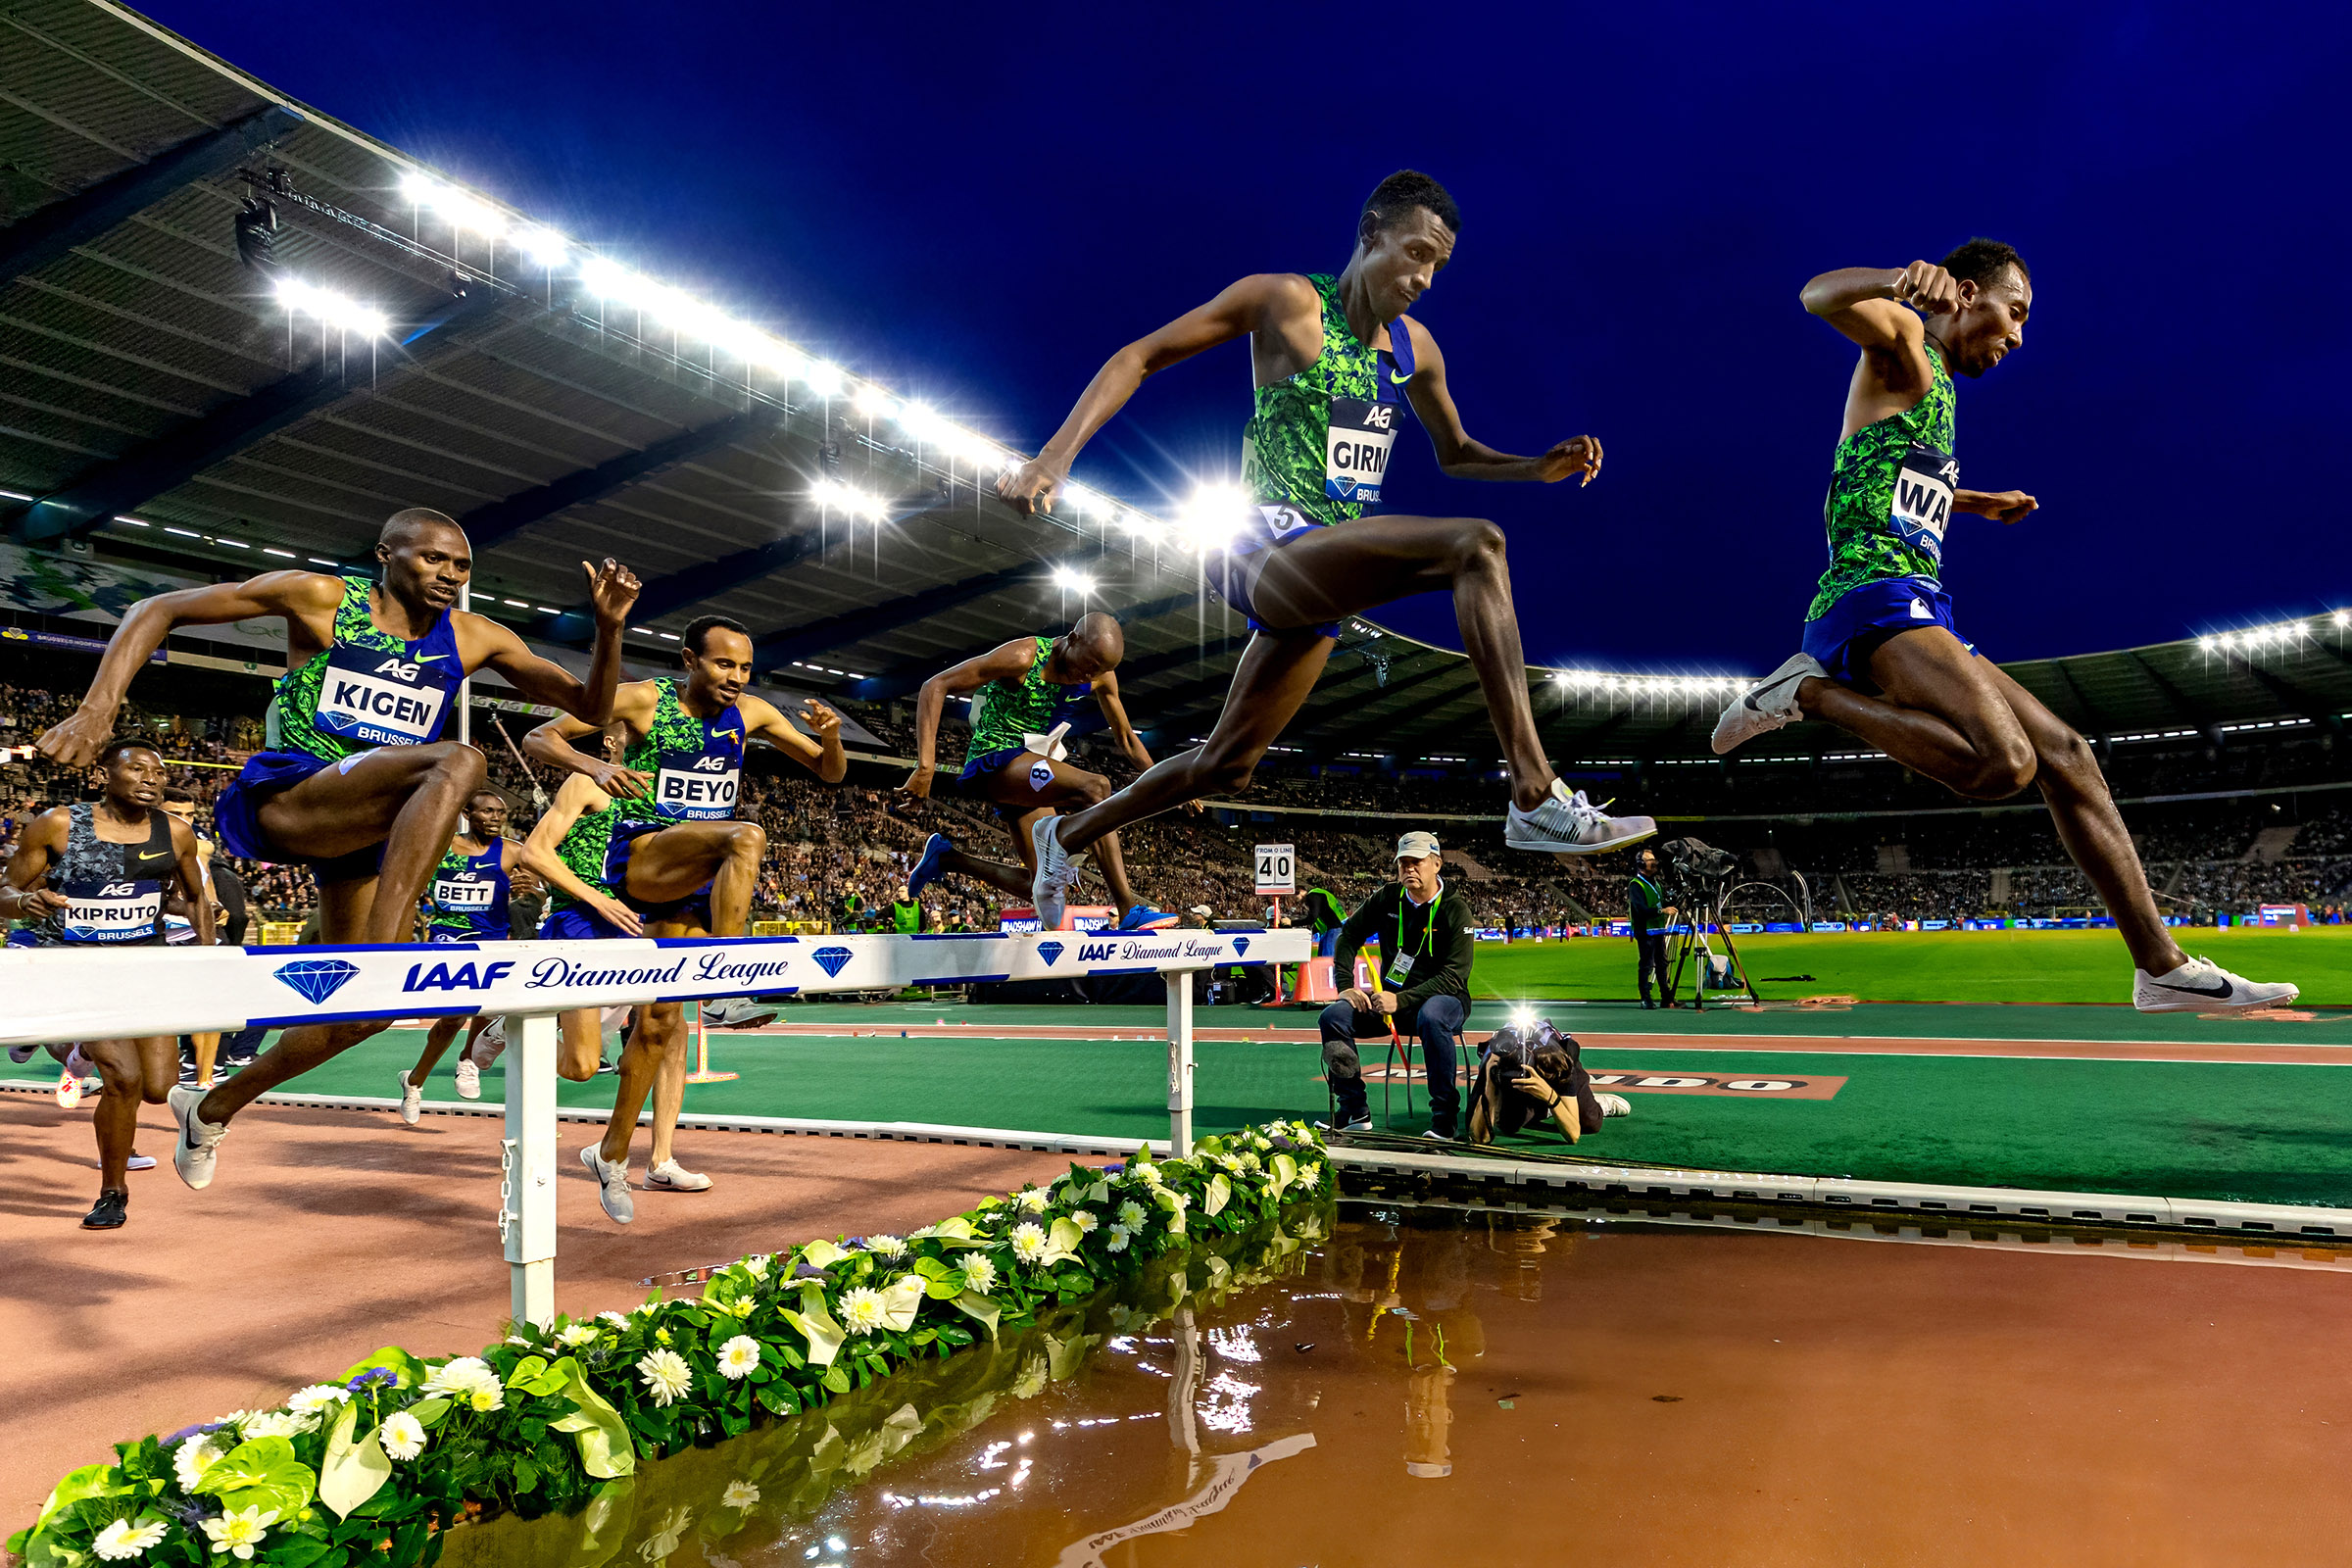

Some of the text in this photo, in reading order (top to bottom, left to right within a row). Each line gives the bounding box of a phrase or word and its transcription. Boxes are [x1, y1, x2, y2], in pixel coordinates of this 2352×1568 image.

[1363, 405, 1393, 428] AG
[1900, 478, 1951, 533] WA
[1274, 504, 1295, 530] 5
[373, 658, 421, 682] AG
[333, 680, 431, 727] KIGEN
[693, 756, 725, 771] AG
[1031, 767, 1051, 781] 8
[663, 776, 735, 803] BEYO
[687, 809, 731, 819] BRUSSELS
[453, 871, 477, 881] AG
[1259, 857, 1290, 877] 40
[97, 882, 135, 897] AG
[439, 885, 489, 901] BETT
[68, 905, 157, 921] KIPRUTO
[98, 927, 153, 940] BRUSSELS
[1077, 939, 1223, 961] IAAF Diamond League
[402, 952, 789, 992] IAAF Diamond League
